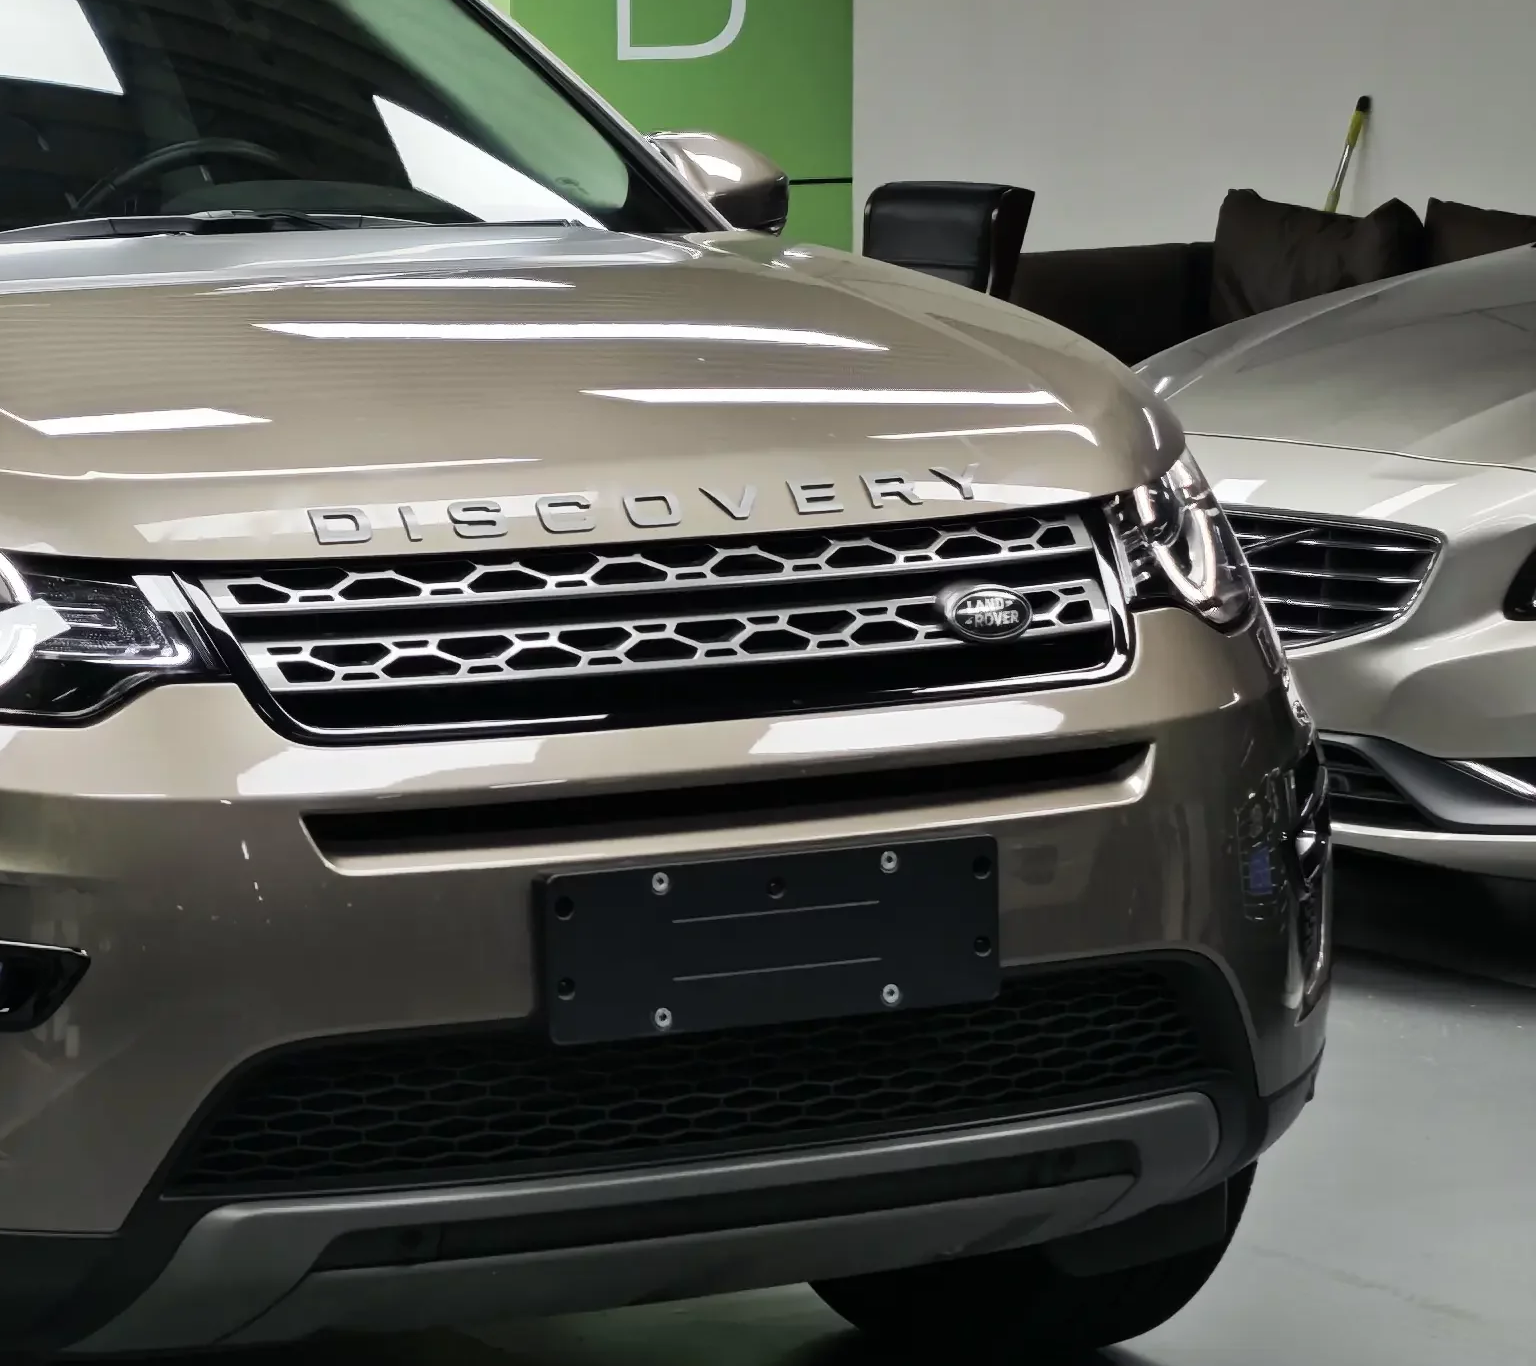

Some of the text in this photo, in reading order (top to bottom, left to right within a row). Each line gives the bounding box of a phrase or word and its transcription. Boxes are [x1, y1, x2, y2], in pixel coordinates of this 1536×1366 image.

[307, 462, 982, 545] DISCOVERY
[966, 597, 1005, 611] LAND
[974, 610, 1019, 627] ROVER
